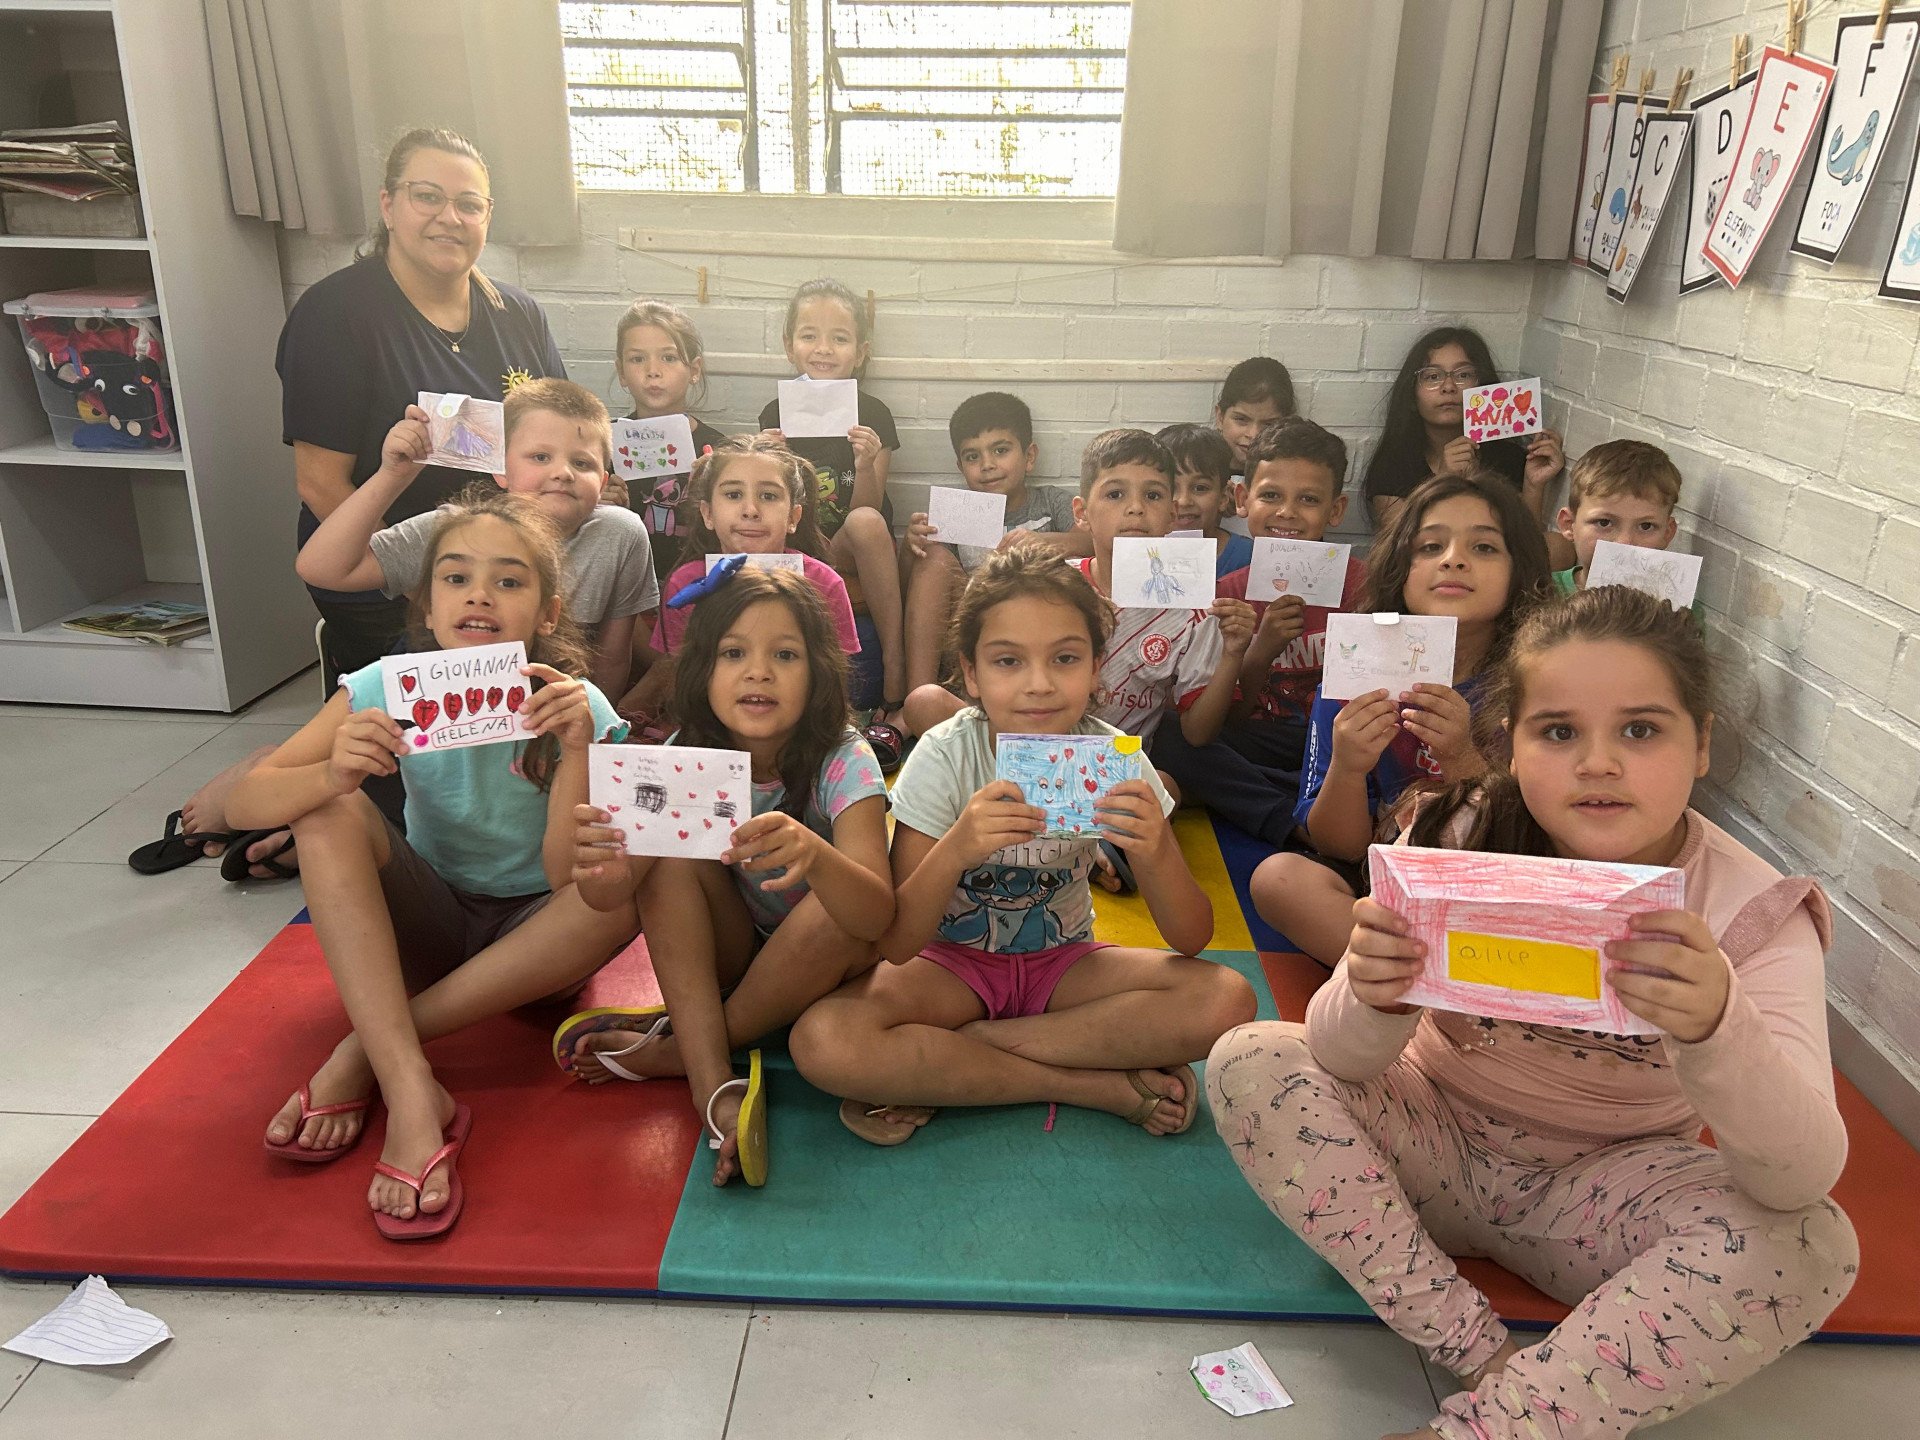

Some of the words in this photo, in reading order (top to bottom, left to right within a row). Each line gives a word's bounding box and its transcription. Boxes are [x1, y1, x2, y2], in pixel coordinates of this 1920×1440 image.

[1860, 43, 1884, 97] F
[1774, 81, 1799, 134] E
[1629, 117, 1644, 158] B
[1717, 109, 1732, 155] D
[1654, 134, 1669, 176] C
[1821, 201, 1842, 221] FOCA
[1724, 211, 1756, 244] ELEFANTE
[437, 717, 509, 745] HELENA
[1322, 1231, 1340, 1242] LOVELY
[1733, 1288, 1754, 1301] LOVELY
[1594, 1332, 1612, 1343] LOVELY
[1655, 1348, 1673, 1370] LOVELY
